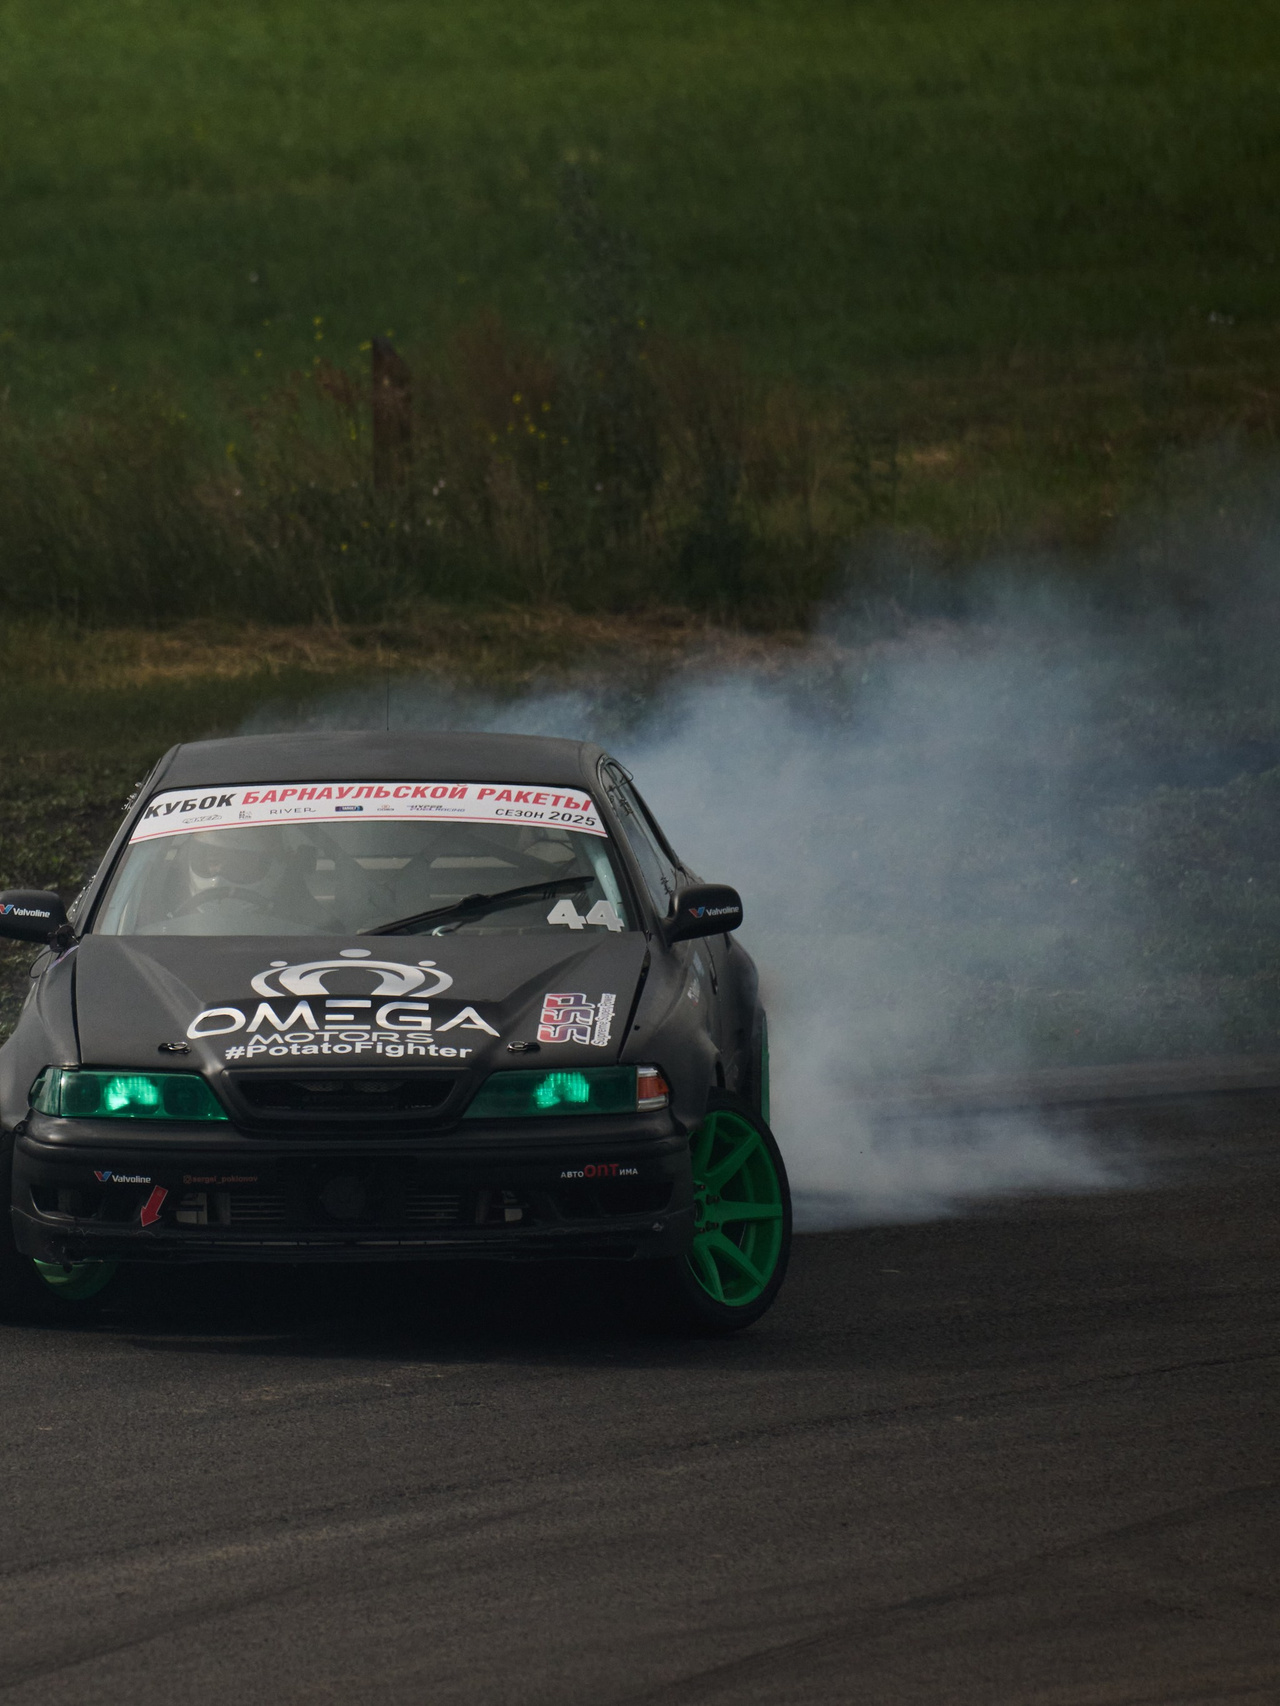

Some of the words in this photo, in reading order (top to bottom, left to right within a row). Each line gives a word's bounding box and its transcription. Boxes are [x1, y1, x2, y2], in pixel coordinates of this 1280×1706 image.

[145, 794, 236, 819] КУБОК
[243, 784, 468, 805] БАРНАУЛЬСКОЙ
[477, 789, 591, 811] РАКЕТЫ
[270, 807, 316, 815] RIVER
[495, 808, 544, 819] СЕЗОН
[548, 811, 596, 826] 2025
[13, 908, 50, 917] Valvoline
[547, 900, 624, 932] 44
[706, 906, 739, 916] Valvoline
[186, 1001, 500, 1038] OMEGA
[249, 1031, 434, 1045] MOTORS
[225, 1040, 473, 1060] #PotatoFighter
[112, 1174, 152, 1184] Valvoline
